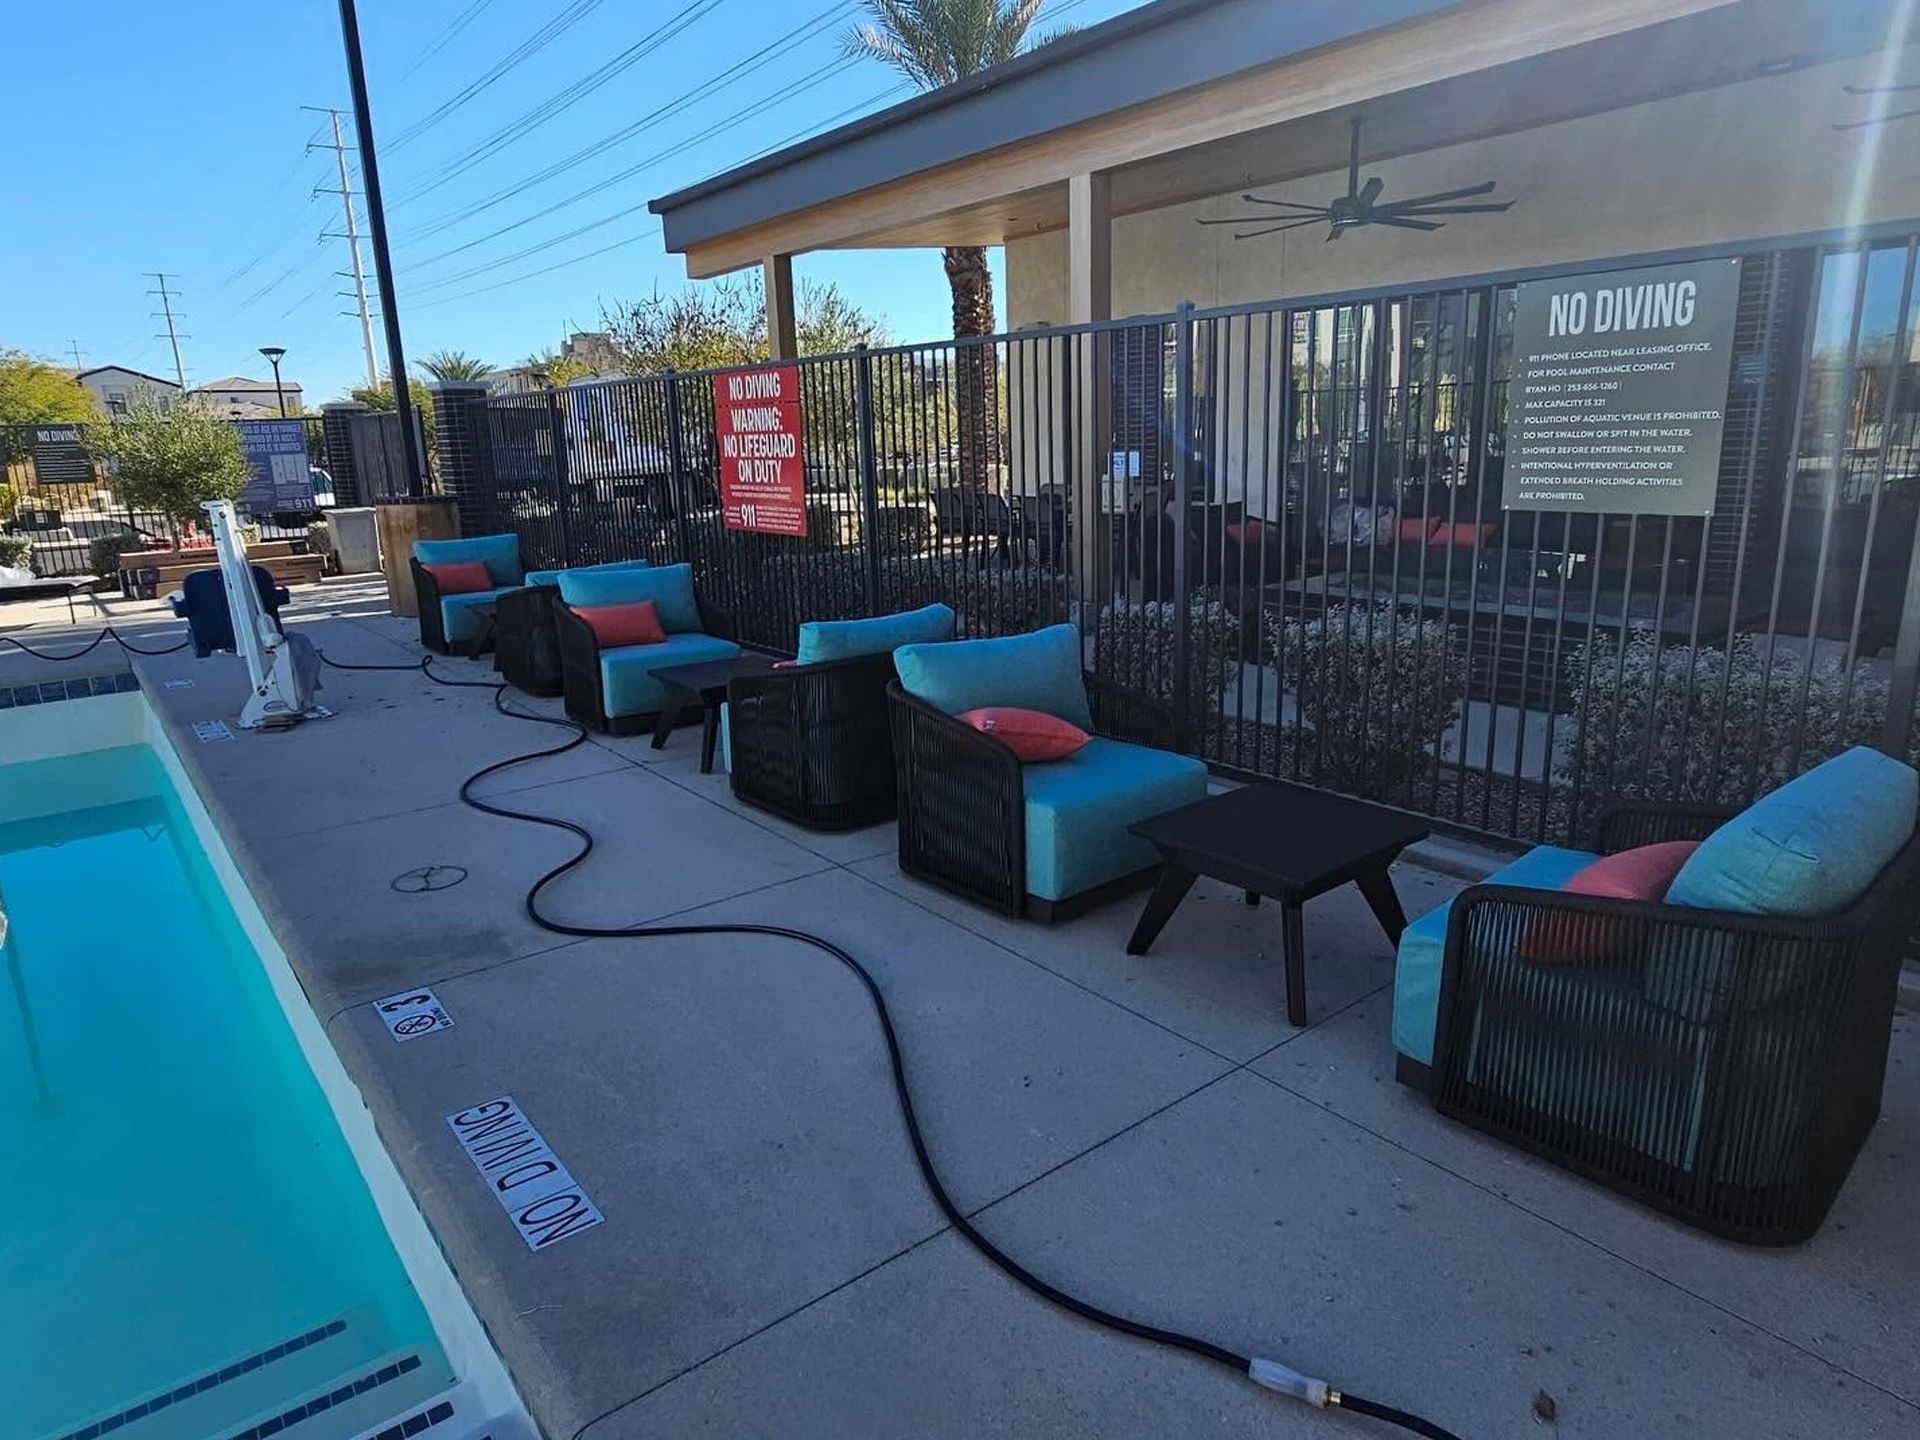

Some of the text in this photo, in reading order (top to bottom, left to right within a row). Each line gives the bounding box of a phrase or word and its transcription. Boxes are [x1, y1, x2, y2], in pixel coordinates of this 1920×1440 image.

[1549, 280, 1697, 336] NO DIVING
[1541, 351, 1570, 362] PHONE
[1571, 349, 1609, 360] LOCATED
[1610, 347, 1636, 358] NEAR
[1636, 344, 1674, 355] LEASING
[1676, 342, 1713, 353] OFFICE.
[1527, 362, 1676, 379] FOR POOL MAINTENANCE CONTACT
[729, 372, 781, 400] NO DIVING
[1525, 384, 1547, 394] RYAN
[1548, 384, 1562, 393] HO
[1525, 400, 1544, 409] MAX
[1544, 399, 1584, 408] CAPACITY
[1584, 399, 1593, 407] IS
[731, 407, 783, 432] WARNING:
[1524, 410, 1721, 425] POLLUTION OF AQUATIC VENUE IS PROHIBITED.
[36, 430, 50, 442] NO
[1523, 428, 1693, 440] DO NOT SWALLOW OR SPIT IN THE WATER.
[723, 433, 796, 458] NO LIFEGUARD
[1521, 446, 1557, 455] SHOWER
[1557, 446, 1590, 454] BEFORE
[1590, 446, 1633, 454] ENTERING
[1634, 445, 1651, 454] THE
[738, 459, 782, 484] ON DUTY
[1520, 462, 1673, 470] INTENTIONAL HYPERVENTILATION OR
[1520, 476, 1683, 486] EXTENDED BREATH HOLDING ACTIVITIES
[294, 499, 313, 509] 911
[1519, 492, 1585, 501] ARE PROHIBITED.
[741, 503, 756, 527] 911
[453, 1100, 597, 1247] NO DIVING
